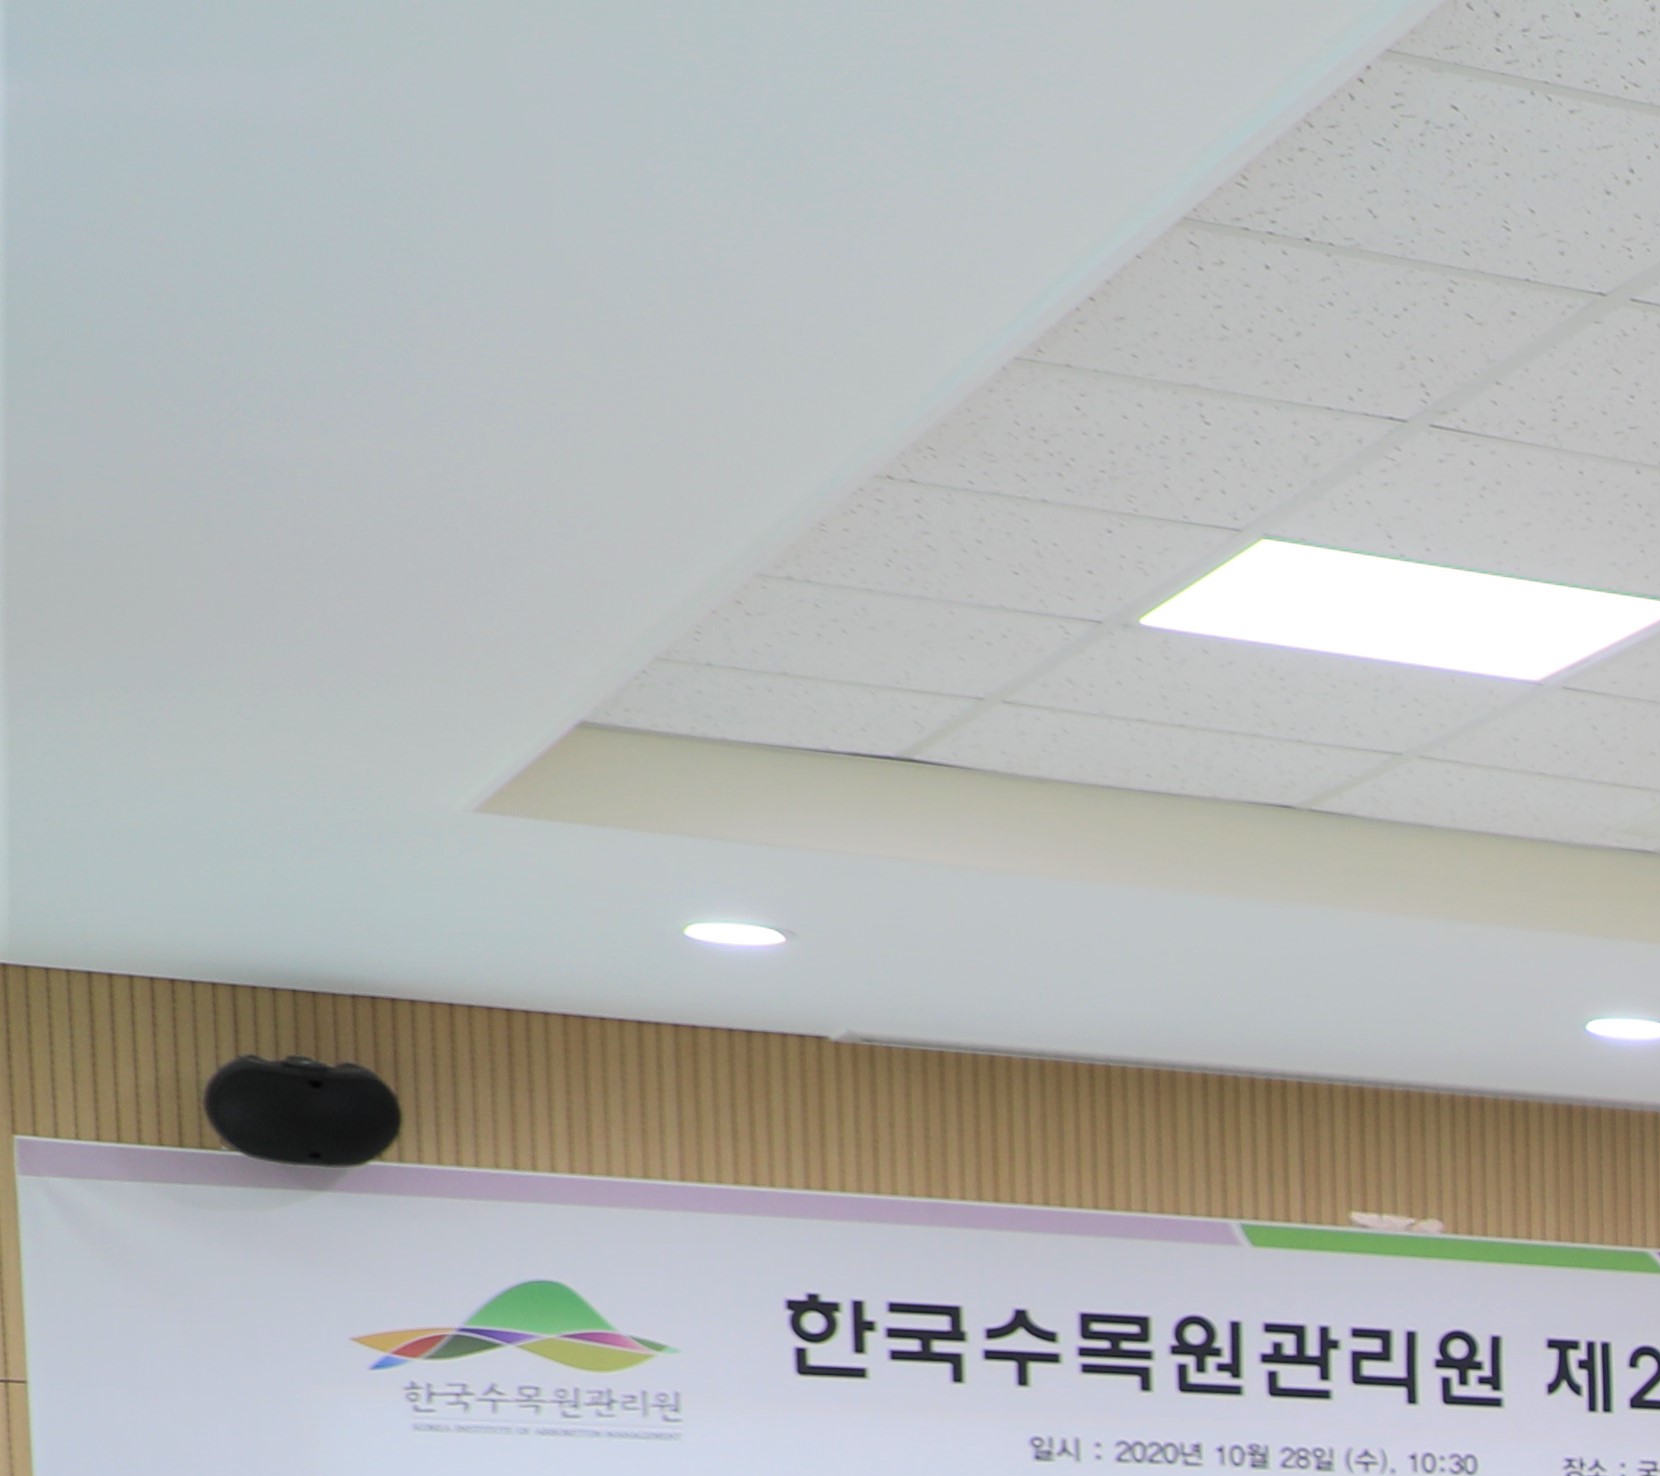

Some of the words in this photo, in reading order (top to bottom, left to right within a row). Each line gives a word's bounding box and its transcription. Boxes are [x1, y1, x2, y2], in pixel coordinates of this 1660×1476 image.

[784, 1292, 1504, 1409] 한국수목원관리원
[403, 1380, 683, 1423] 한국수목원관리원
[1028, 1435, 1082, 1463] 일시
[1114, 1439, 1204, 1468] 2020년
[1215, 1443, 1271, 1470] 10월
[1279, 1445, 1336, 1473] 28일
[1407, 1452, 1480, 1476] 10:30
